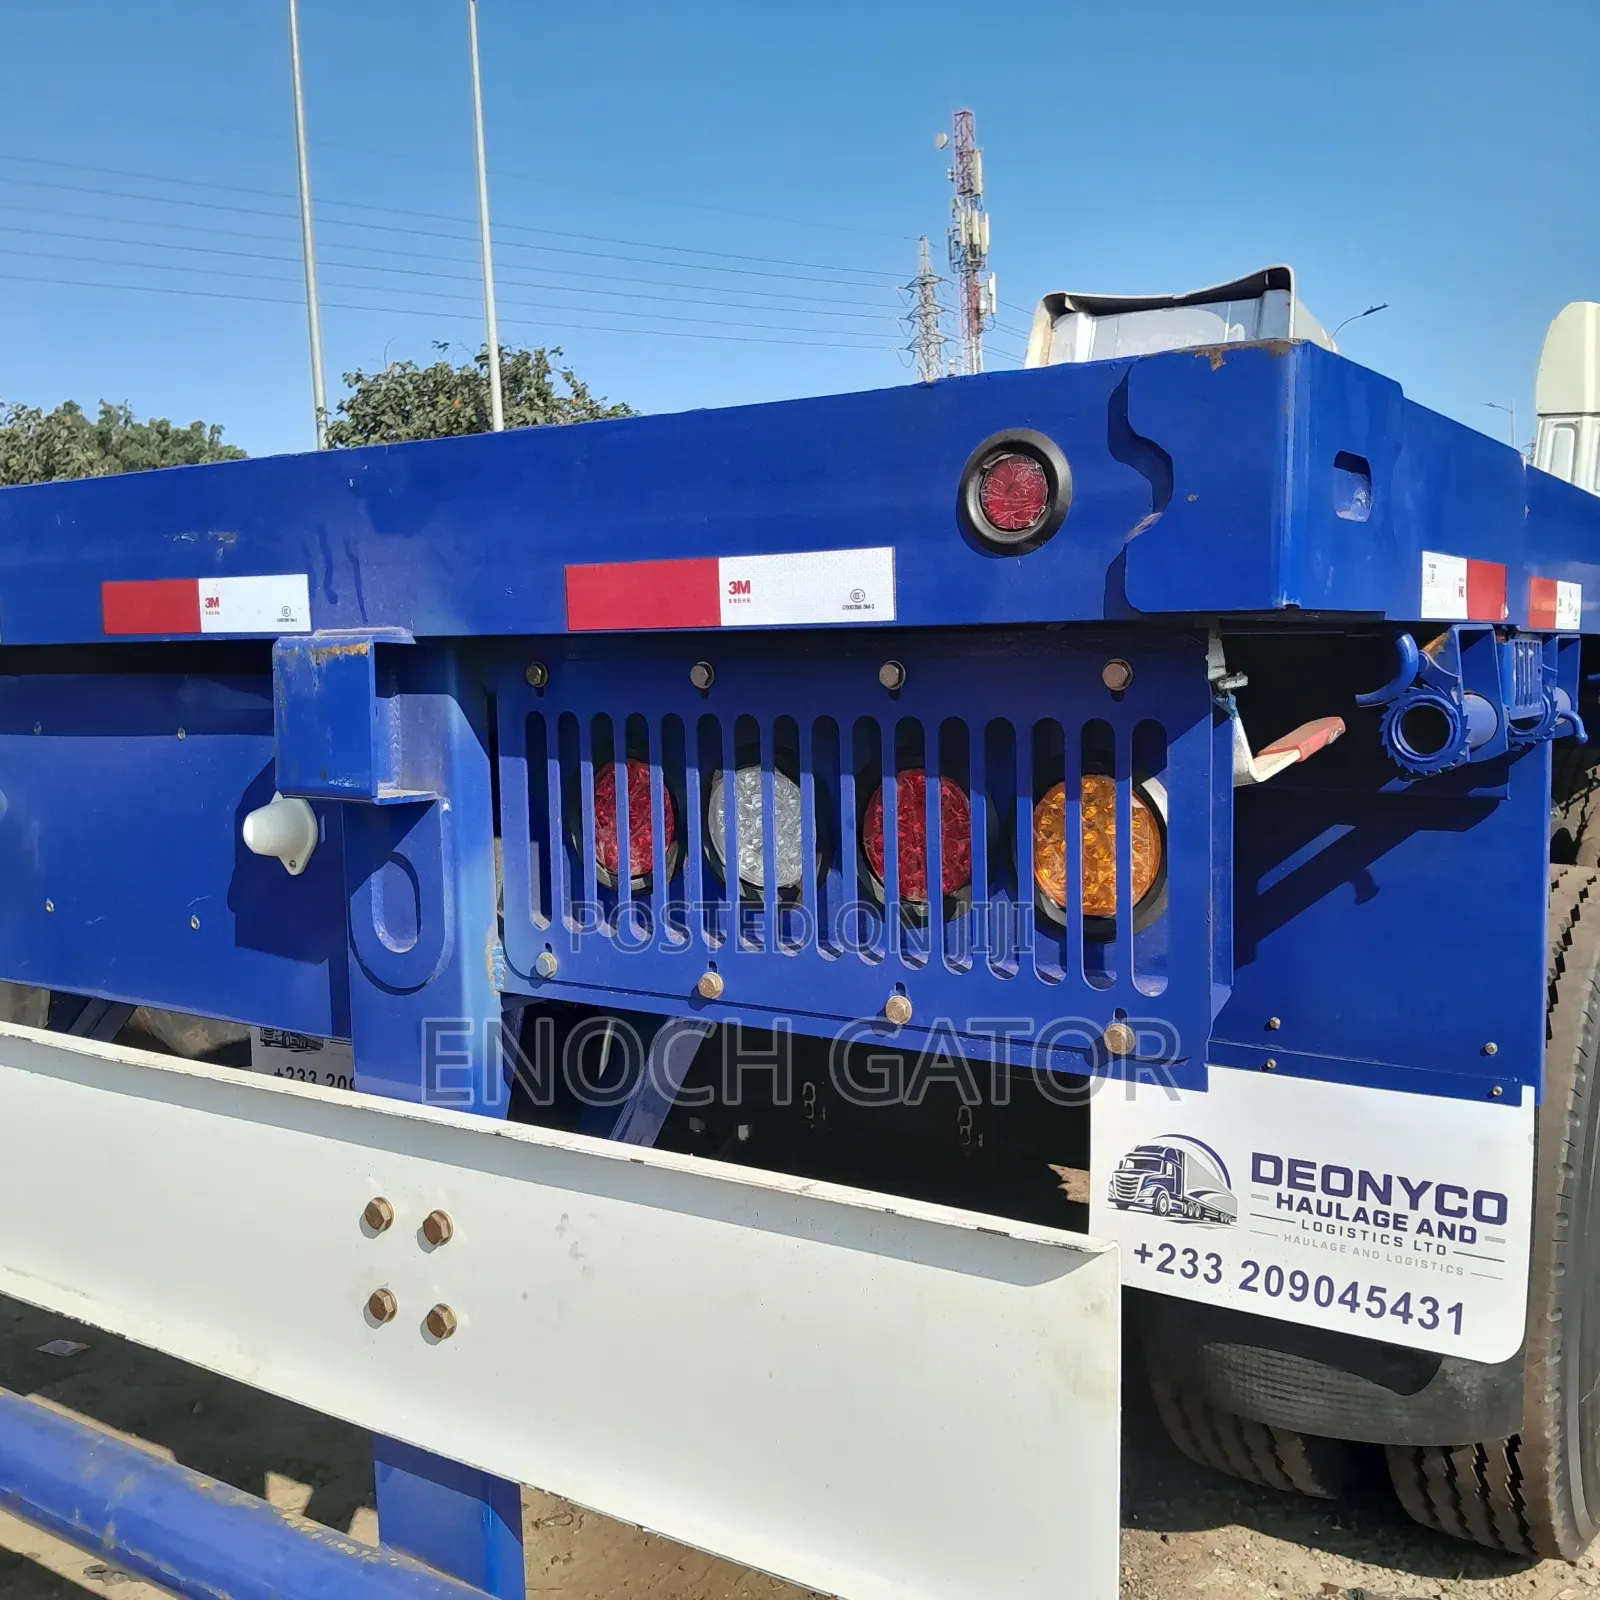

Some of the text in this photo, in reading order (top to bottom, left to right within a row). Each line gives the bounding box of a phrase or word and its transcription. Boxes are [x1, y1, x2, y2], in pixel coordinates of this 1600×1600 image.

[205, 597, 220, 609] 3M
[728, 579, 751, 595] 3M
[1251, 1151, 1508, 1226] DEONYCO
[1276, 1191, 1477, 1245] HAULAGE AND
[1301, 1218, 1447, 1256] LOGISTICS LTD
[1283, 1233, 1464, 1276] HAULAGE AND LOGISTICS
[1133, 1242, 1464, 1336] +233 209045431
